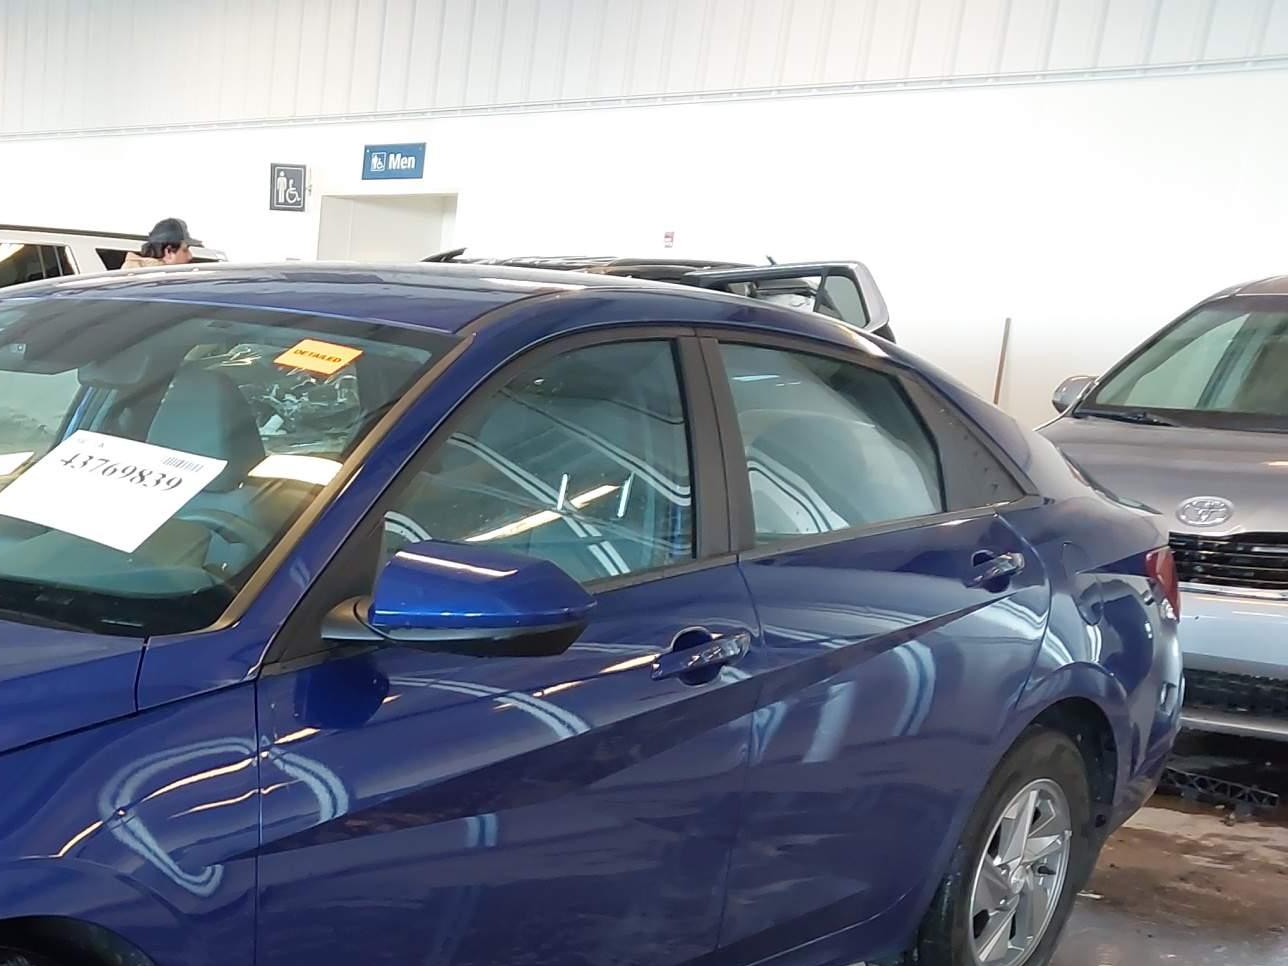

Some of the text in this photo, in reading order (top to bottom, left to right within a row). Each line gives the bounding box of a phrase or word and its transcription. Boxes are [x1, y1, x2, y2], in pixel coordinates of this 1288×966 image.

[388, 152, 416, 170] Men
[293, 348, 342, 363] DETAILED
[60, 452, 183, 492] 43769839
